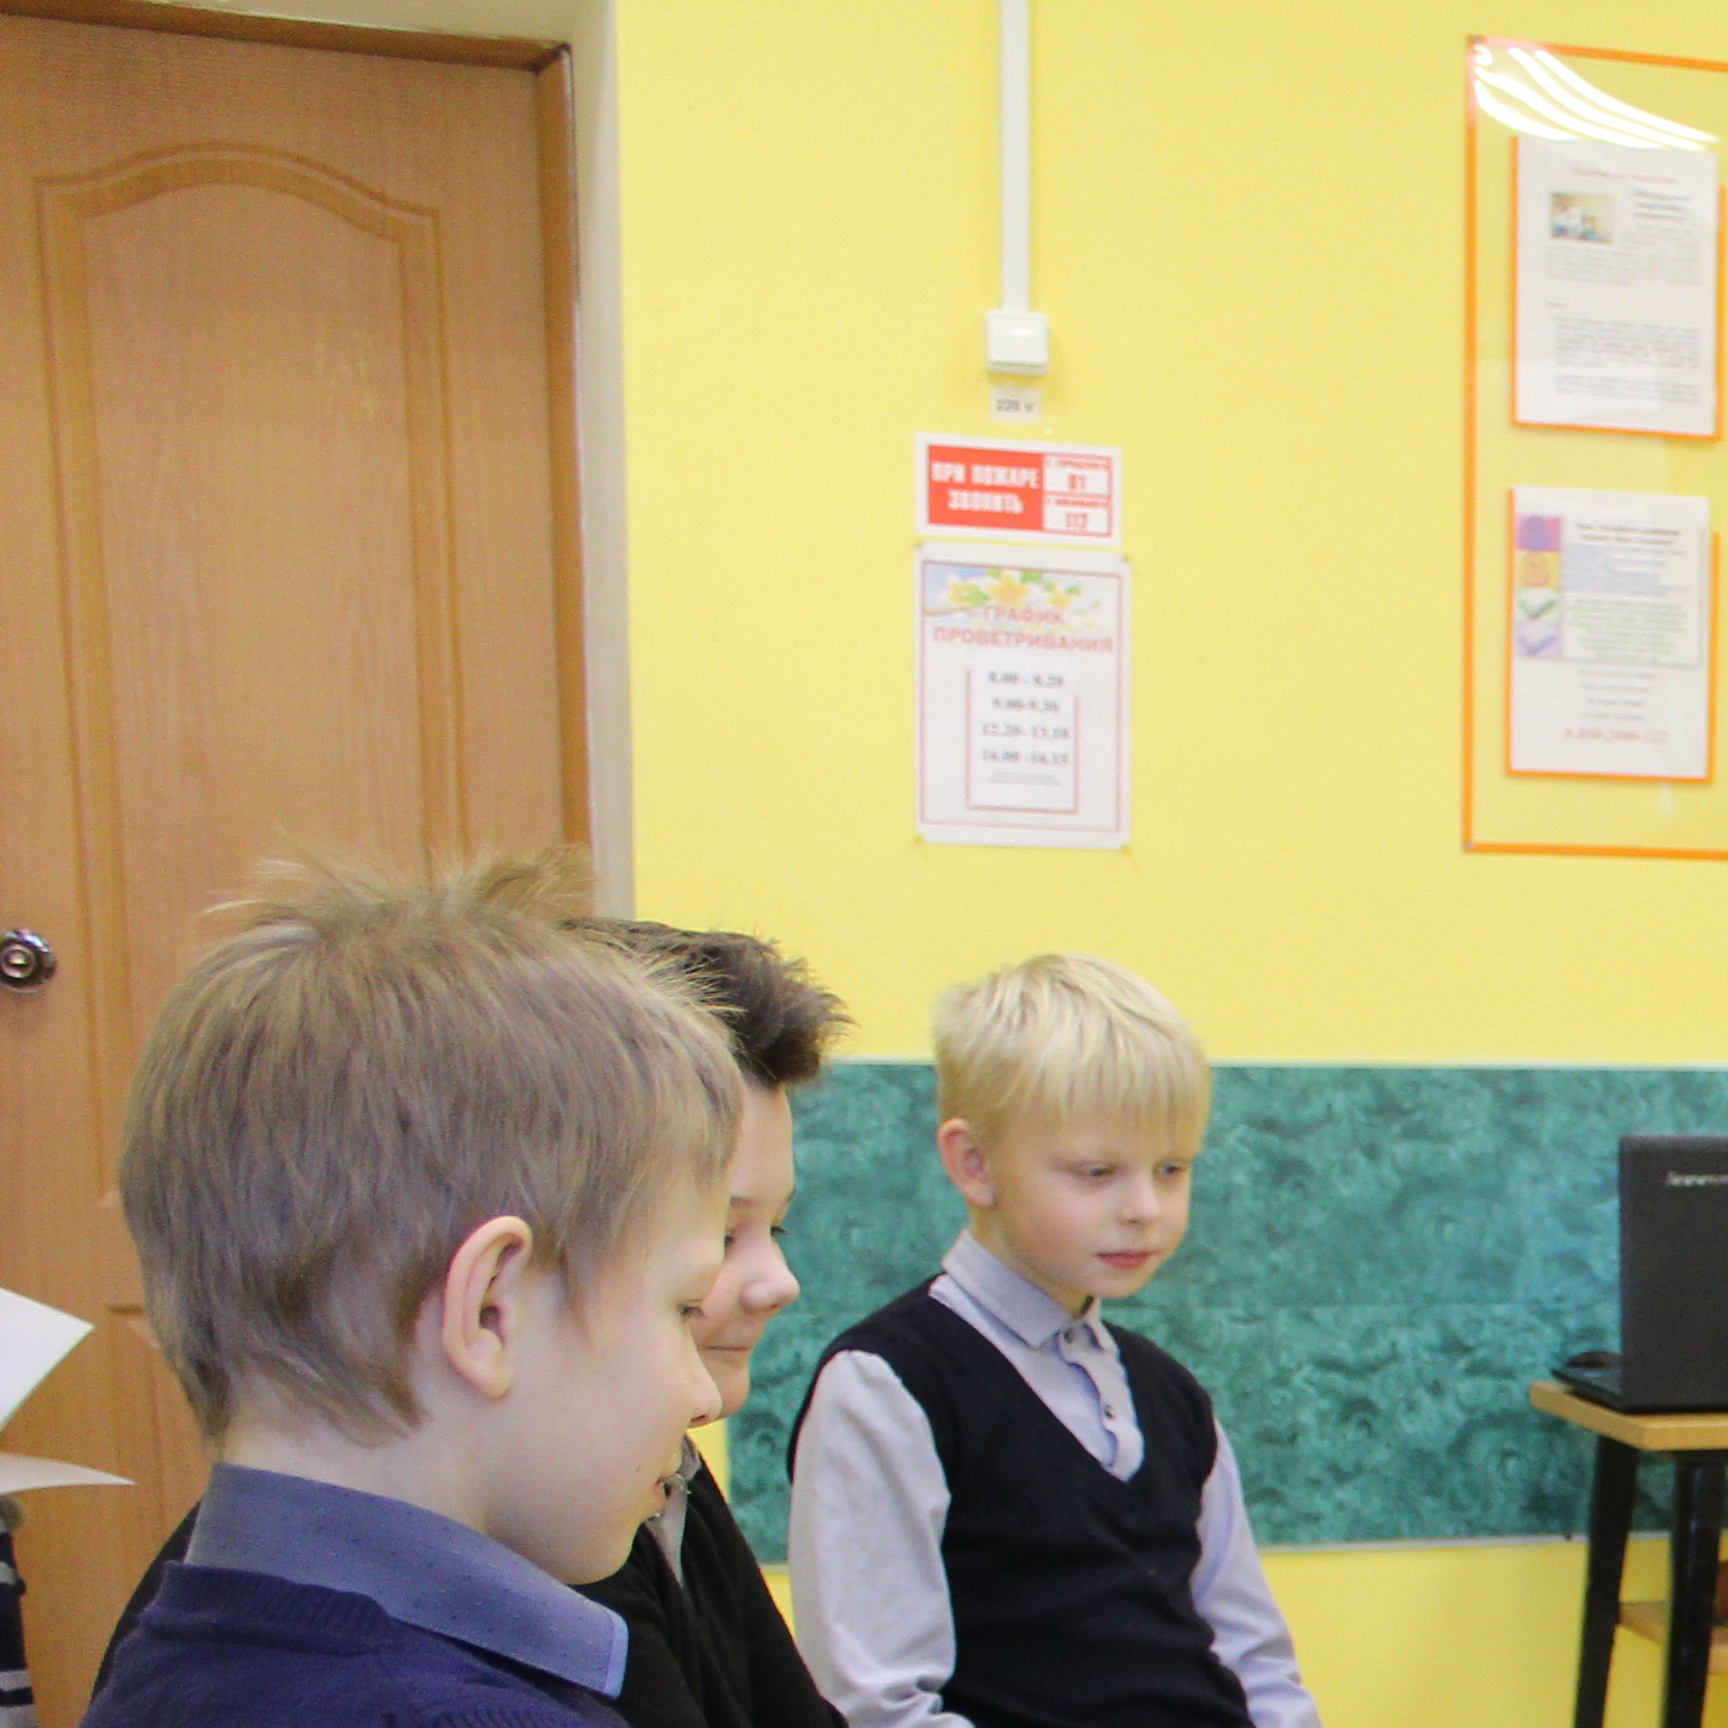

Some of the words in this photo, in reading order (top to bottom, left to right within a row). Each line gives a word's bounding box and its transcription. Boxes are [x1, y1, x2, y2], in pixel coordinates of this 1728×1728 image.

[931, 461, 966, 483] ПРИ
[971, 464, 1039, 489] ПОЖАРЕ
[948, 489, 1025, 514] ЗВОНИТЬ
[984, 605, 1064, 625] ГРАФИК
[934, 626, 1115, 652] ПРОВЕТРИВАНИЯ
